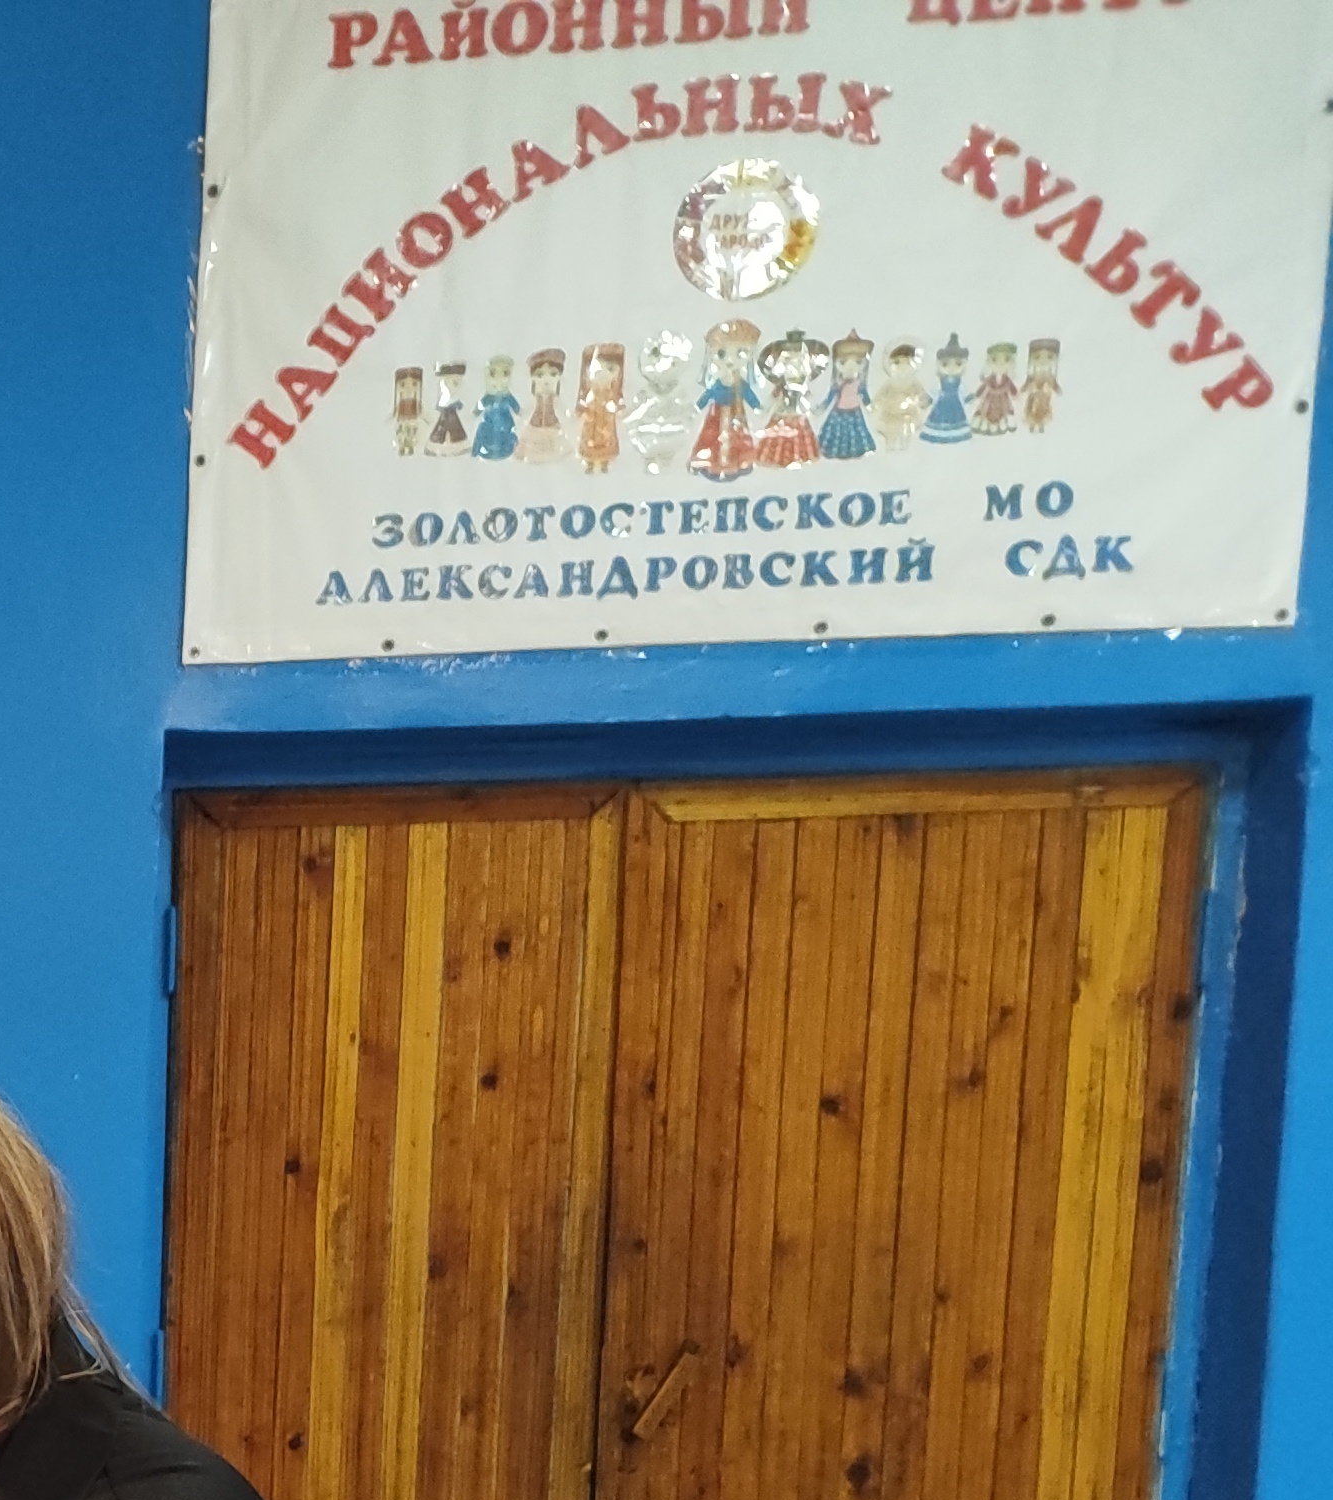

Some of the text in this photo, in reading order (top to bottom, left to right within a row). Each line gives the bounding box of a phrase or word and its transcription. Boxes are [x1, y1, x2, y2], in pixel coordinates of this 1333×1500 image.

[227, 71, 1275, 470] НАЦИОНАЛЬНЫХ КУЛЬТУР
[370, 480, 1075, 548] ЗОЛОТОСТЕПСКОЕ МО
[315, 534, 1134, 606] АЛЕКСАНДРОВСКИЙ СДК
